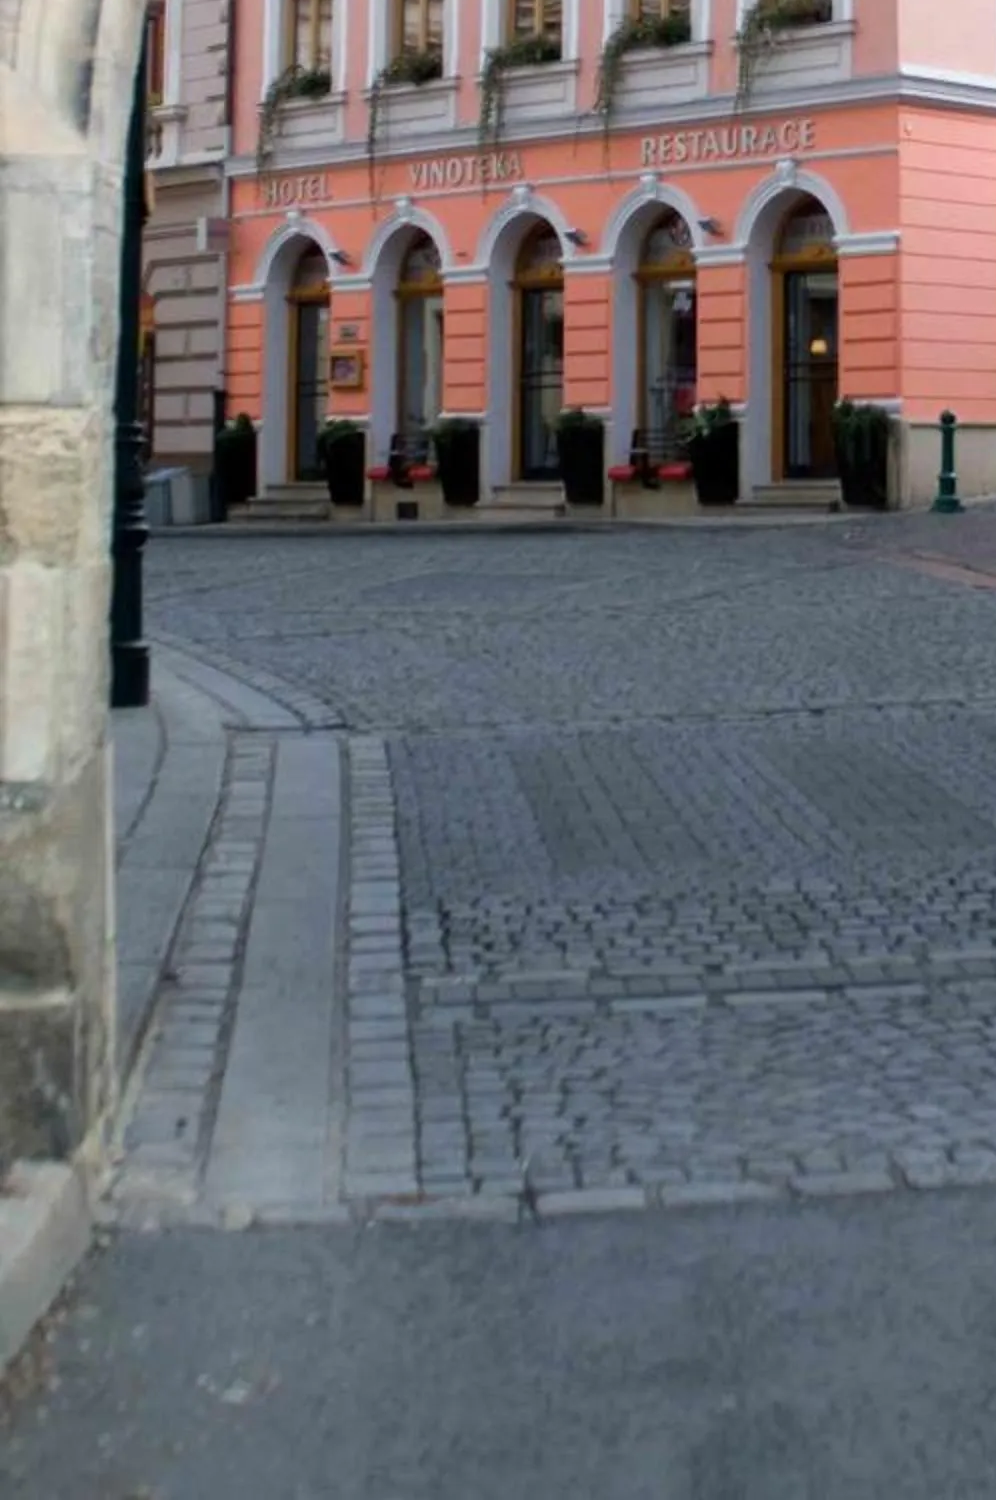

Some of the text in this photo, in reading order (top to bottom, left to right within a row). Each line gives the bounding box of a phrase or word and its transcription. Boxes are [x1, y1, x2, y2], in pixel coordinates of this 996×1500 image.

[641, 117, 817, 167] RESTAURACE
[409, 150, 524, 188] VINOTEKA
[264, 174, 333, 207] HOTEL
